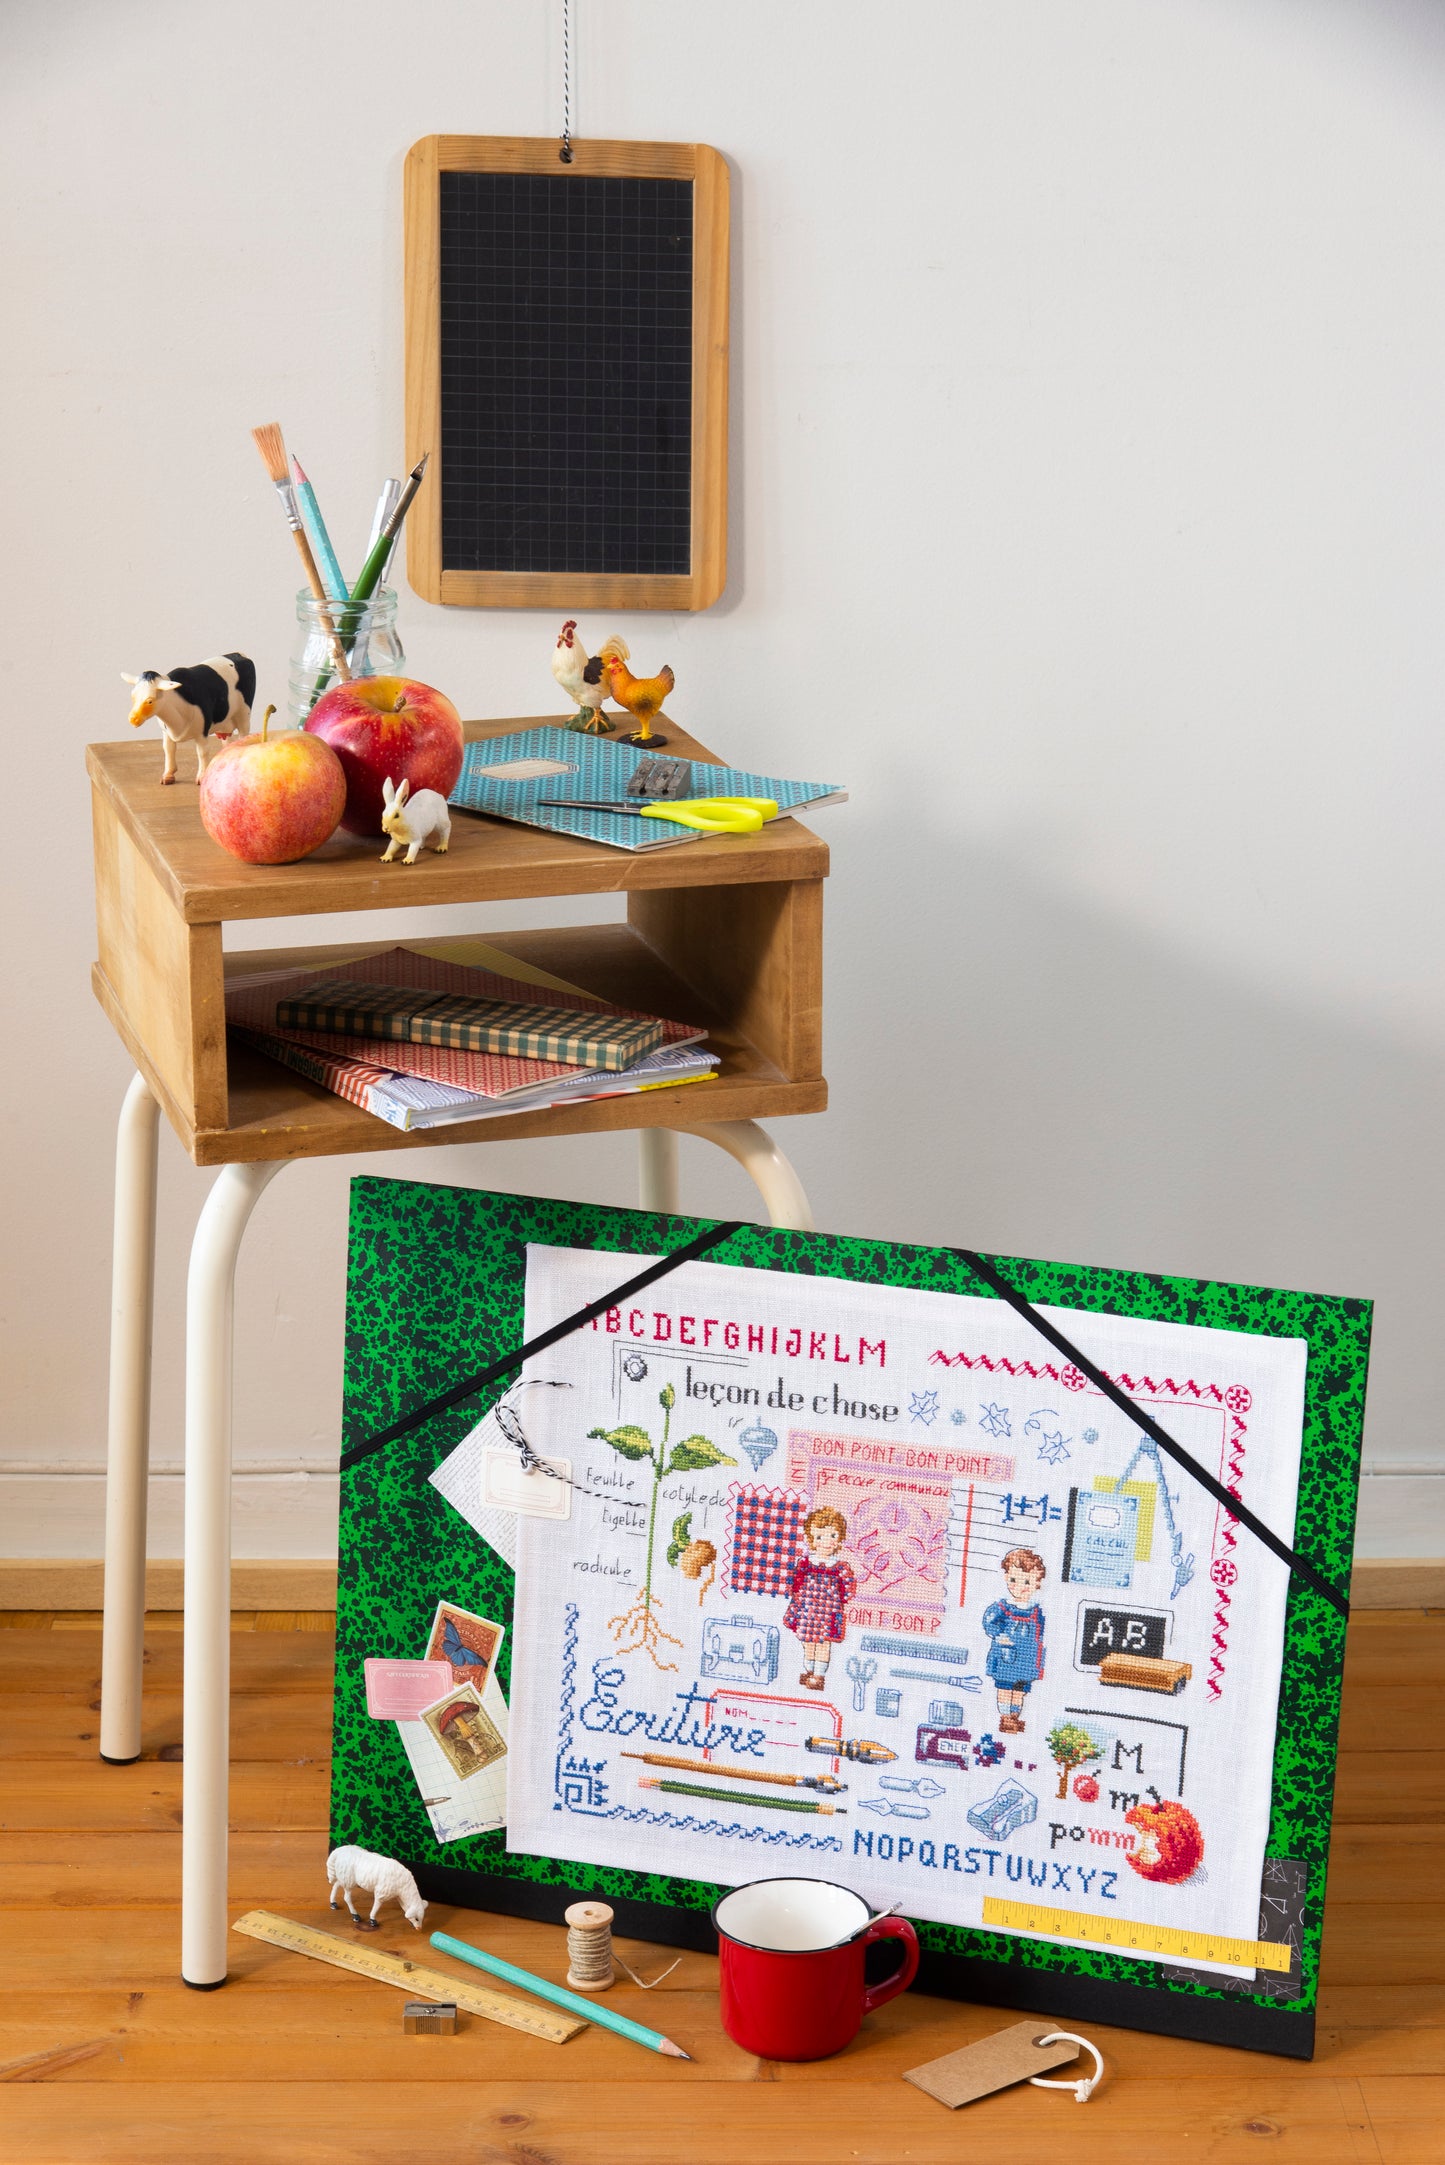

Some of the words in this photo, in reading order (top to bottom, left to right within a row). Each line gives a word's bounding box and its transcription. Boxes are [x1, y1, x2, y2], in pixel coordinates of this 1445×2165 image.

[686, 1365, 760, 1408] leçon
[767, 1376, 805, 1411] de
[812, 1383, 899, 1423] chose
[812, 1438, 845, 1458] BON
[850, 1442, 896, 1464] POINT
[905, 1450, 938, 1470] BON
[944, 1454, 991, 1476] POINT
[572, 1553, 632, 1578] radicule
[892, 1612, 924, 1632] BON
[725, 1706, 748, 1719] NOM
[1110, 1739, 1145, 1775] M
[1029, 1920, 1035, 1928] 2
[1055, 1924, 1061, 1932] 3
[1105, 1933, 1111, 1941] 5
[1131, 1937, 1137, 1945] 6
[1182, 1946, 1189, 1954] 8
[1227, 1953, 1240, 1962] 10
[1254, 1956, 1265, 1965] 11
